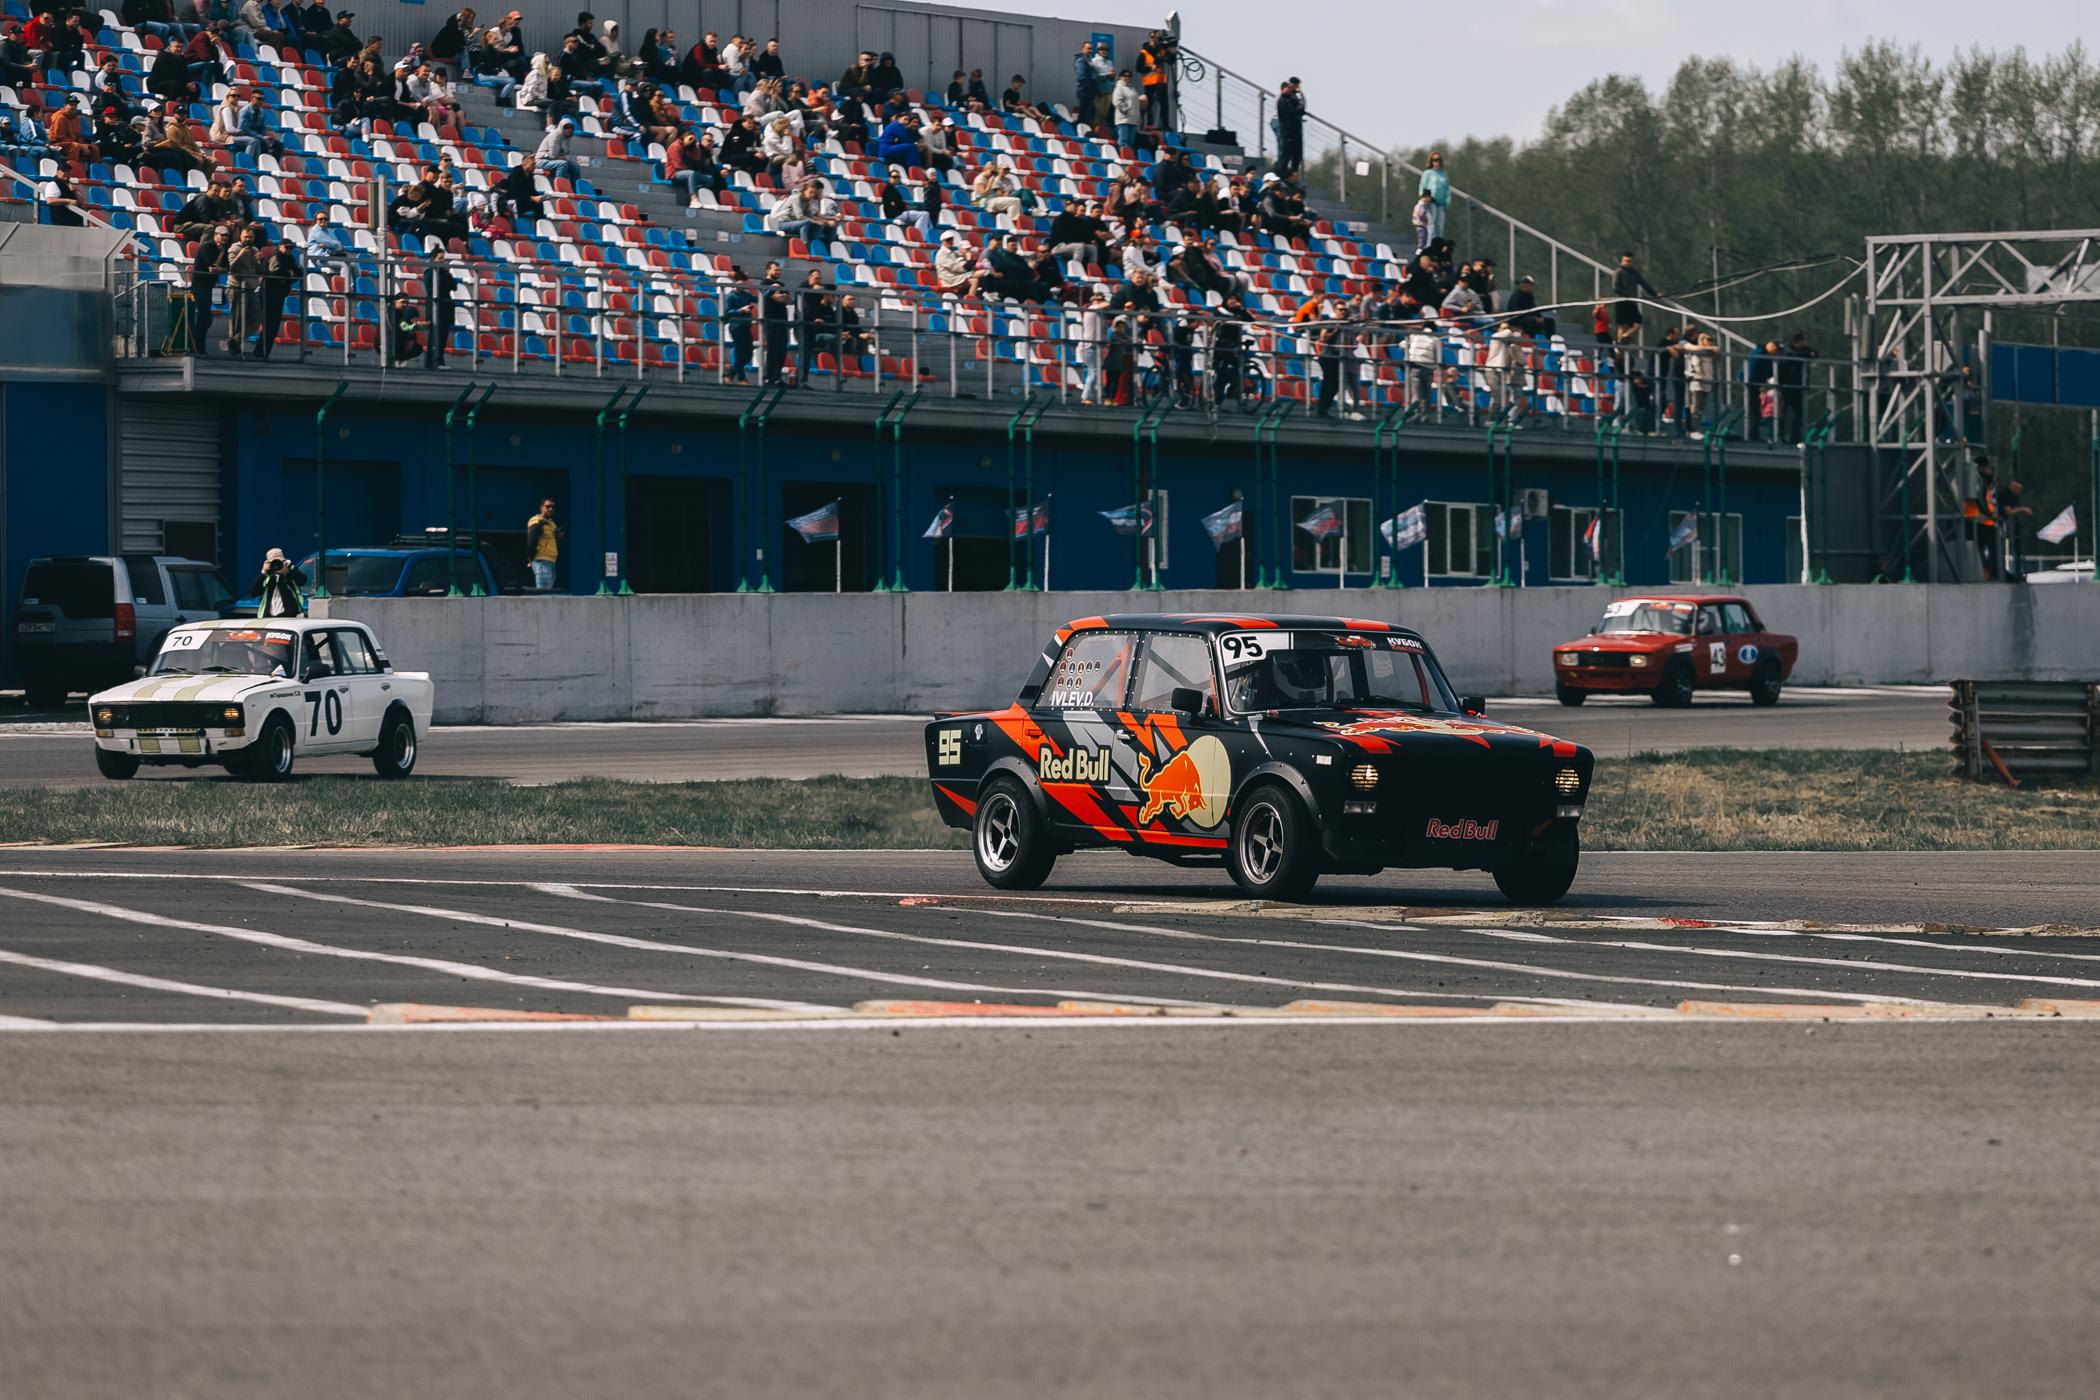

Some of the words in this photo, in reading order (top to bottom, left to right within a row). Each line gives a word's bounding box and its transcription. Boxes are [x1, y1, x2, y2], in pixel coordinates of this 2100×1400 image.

[172, 635, 193, 647] 70
[1223, 636, 1263, 659] 95
[1386, 637, 1422, 649] КУБОК
[304, 689, 342, 736] 70
[939, 729, 962, 765] 95
[1040, 747, 1074, 780] Red
[1076, 749, 1110, 781] Bull
[1426, 818, 1465, 839] Red
[1463, 820, 1499, 840] Bull
